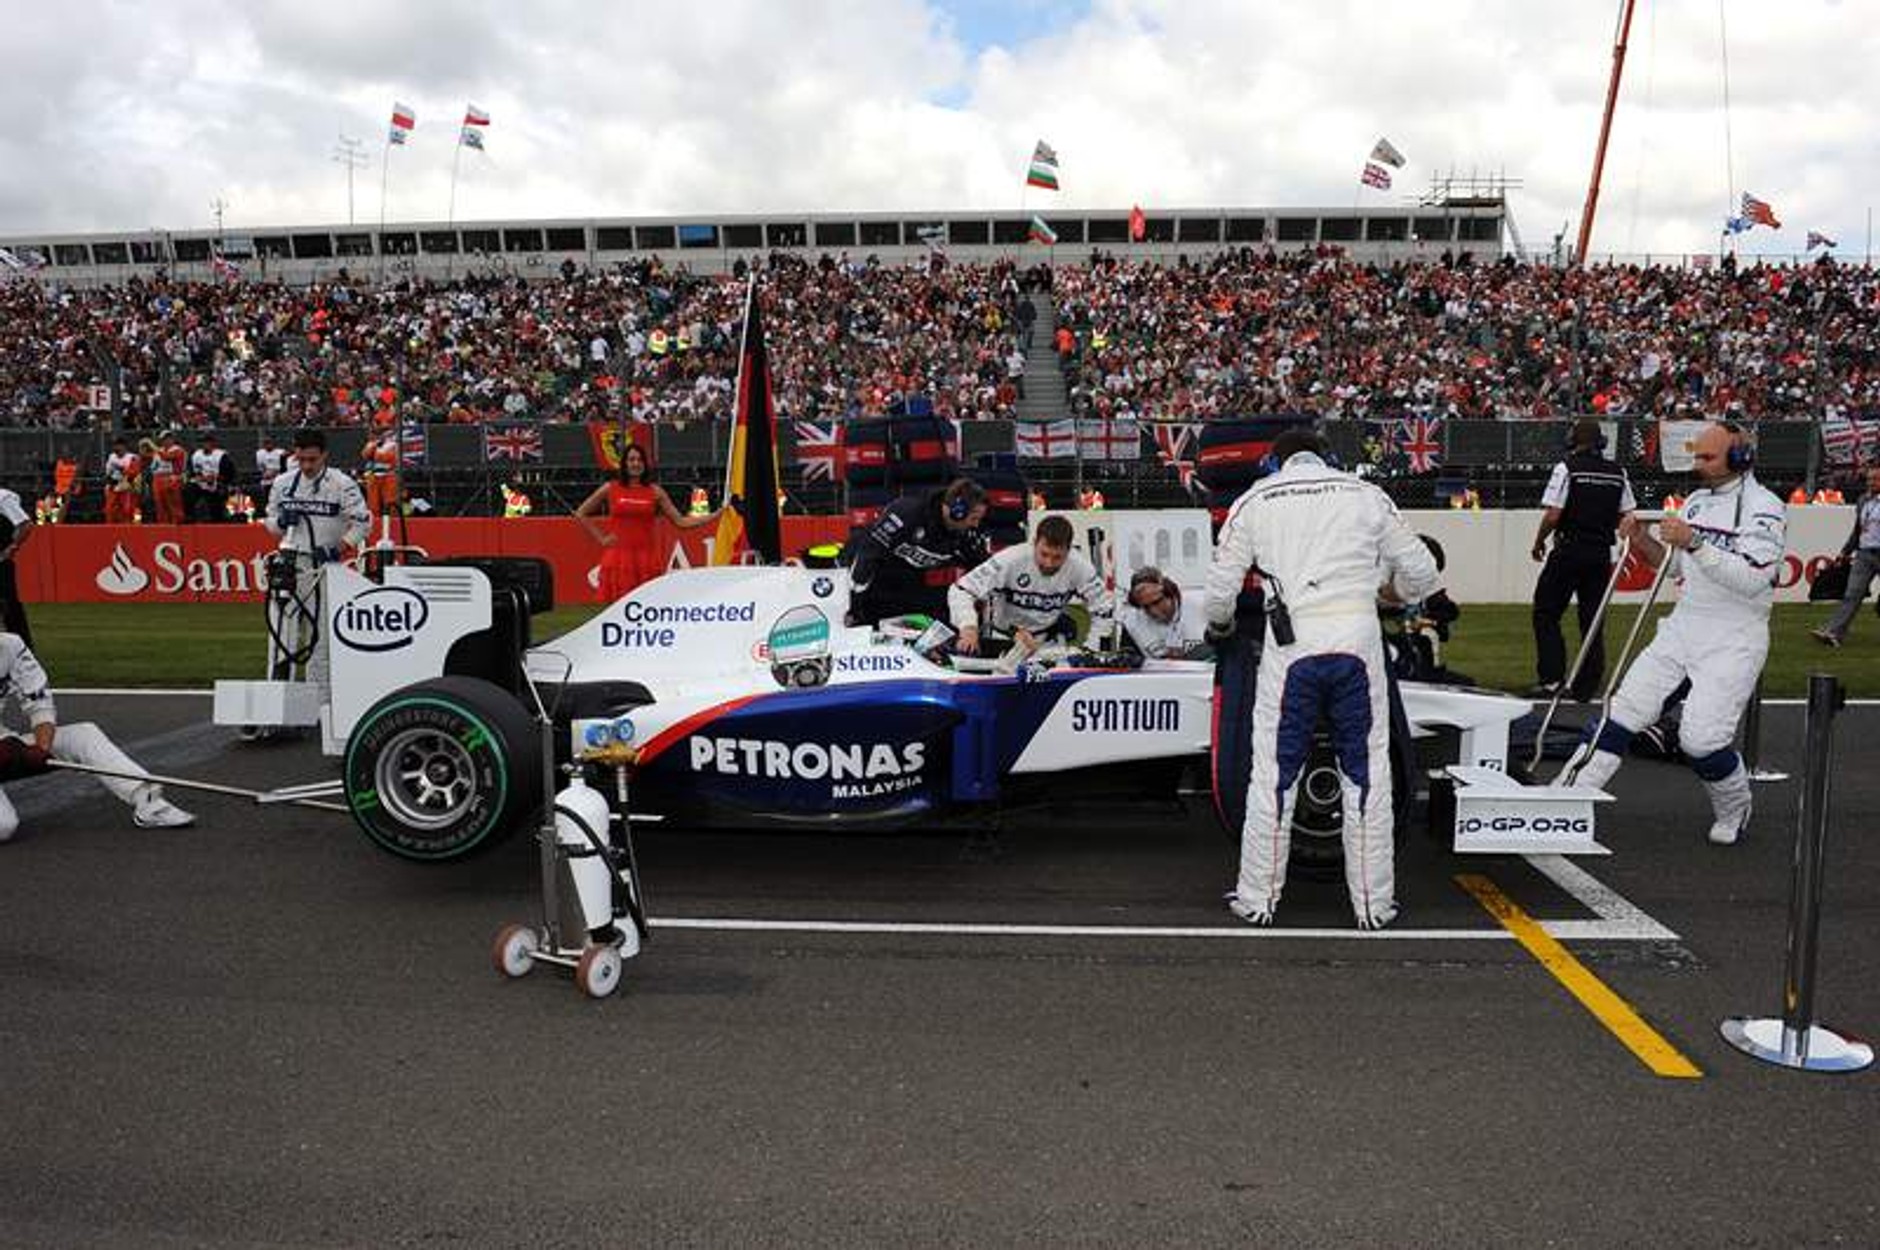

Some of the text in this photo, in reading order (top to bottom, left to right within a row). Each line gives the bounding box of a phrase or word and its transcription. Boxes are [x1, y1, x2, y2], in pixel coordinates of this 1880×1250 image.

[95, 389, 107, 407] F
[154, 541, 268, 594] Sant
[346, 601, 411, 632] intel
[624, 601, 755, 622] Connected
[601, 622, 675, 648] Drive
[1073, 700, 1179, 732] SYNTIUM
[690, 735, 925, 780] PETRONAS
[832, 775, 923, 799] MALAYSIA
